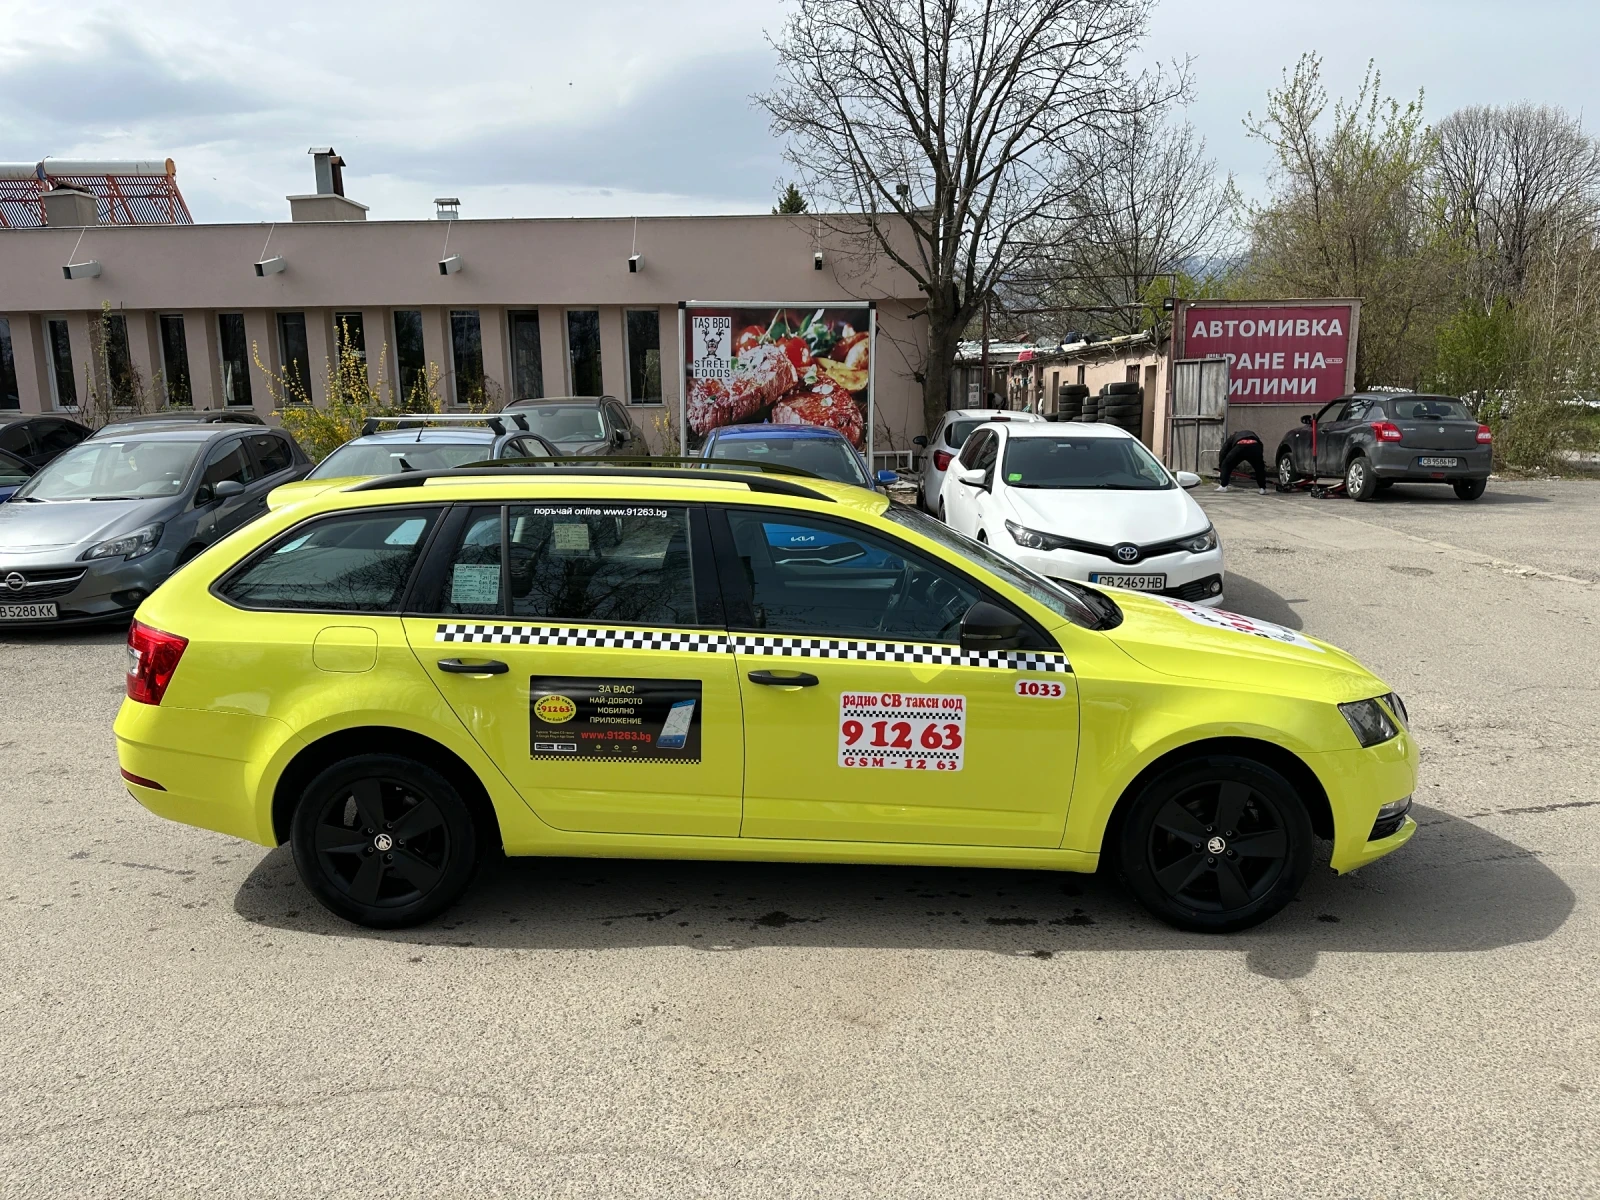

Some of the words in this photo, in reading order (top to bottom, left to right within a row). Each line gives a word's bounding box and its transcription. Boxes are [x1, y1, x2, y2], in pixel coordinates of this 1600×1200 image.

[693, 317, 710, 329] TAS
[712, 317, 731, 329] BBQ
[1191, 318, 1343, 338] АВТОМИВКА
[694, 359, 731, 369] STREET
[1206, 352, 1286, 370] РАНЕ
[1293, 352, 1326, 369] НА
[694, 368, 731, 378] FOODS
[1228, 377, 1317, 395] ИЛИМИ
[533, 506, 573, 517] поръчай
[574, 507, 601, 516] online
[603, 507, 668, 518] www.91263.bg
[1116, 576, 1146, 589] 2469
[1146, 576, 1163, 589] HB
[8, 605, 37, 618] 5288
[38, 604, 55, 617] KK
[598, 684, 611, 693] ЗА
[613, 685, 635, 694] ВАС!
[1018, 682, 1062, 697] 1033
[589, 696, 643, 705] НАЙ-ДОБРОТО
[842, 694, 878, 709] радио
[880, 693, 903, 708] СВ
[905, 696, 939, 709] такси
[941, 698, 964, 712] оод
[597, 706, 635, 715] МОБИЛНО
[589, 716, 643, 725] ПРИЛОЖЕНИЕ
[581, 731, 651, 743] www.91263.bg
